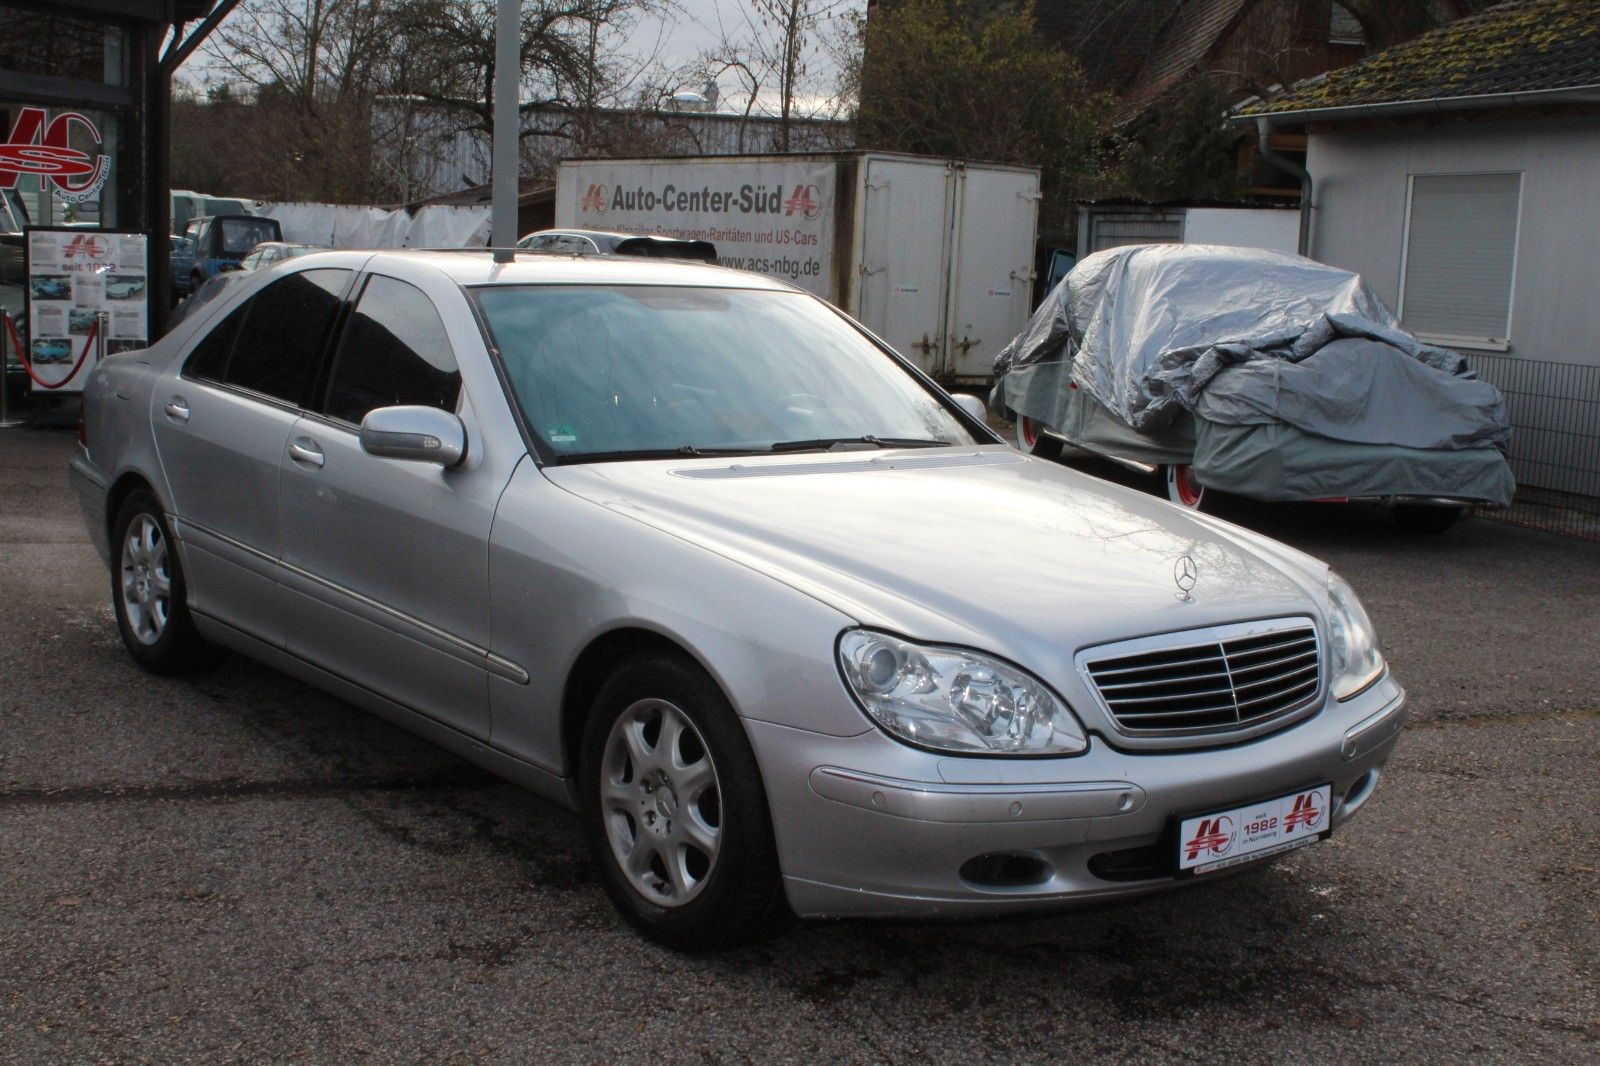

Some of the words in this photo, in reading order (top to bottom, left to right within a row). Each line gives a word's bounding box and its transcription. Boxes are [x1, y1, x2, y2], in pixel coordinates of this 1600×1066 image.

[611, 184, 783, 214] Auto-Center-Süd
[754, 227, 772, 243] und
[775, 229, 818, 246] US-Cars
[62, 262, 83, 272] seit
[717, 255, 820, 279] www.acs-nbg.de
[1243, 817, 1278, 836] 1982
